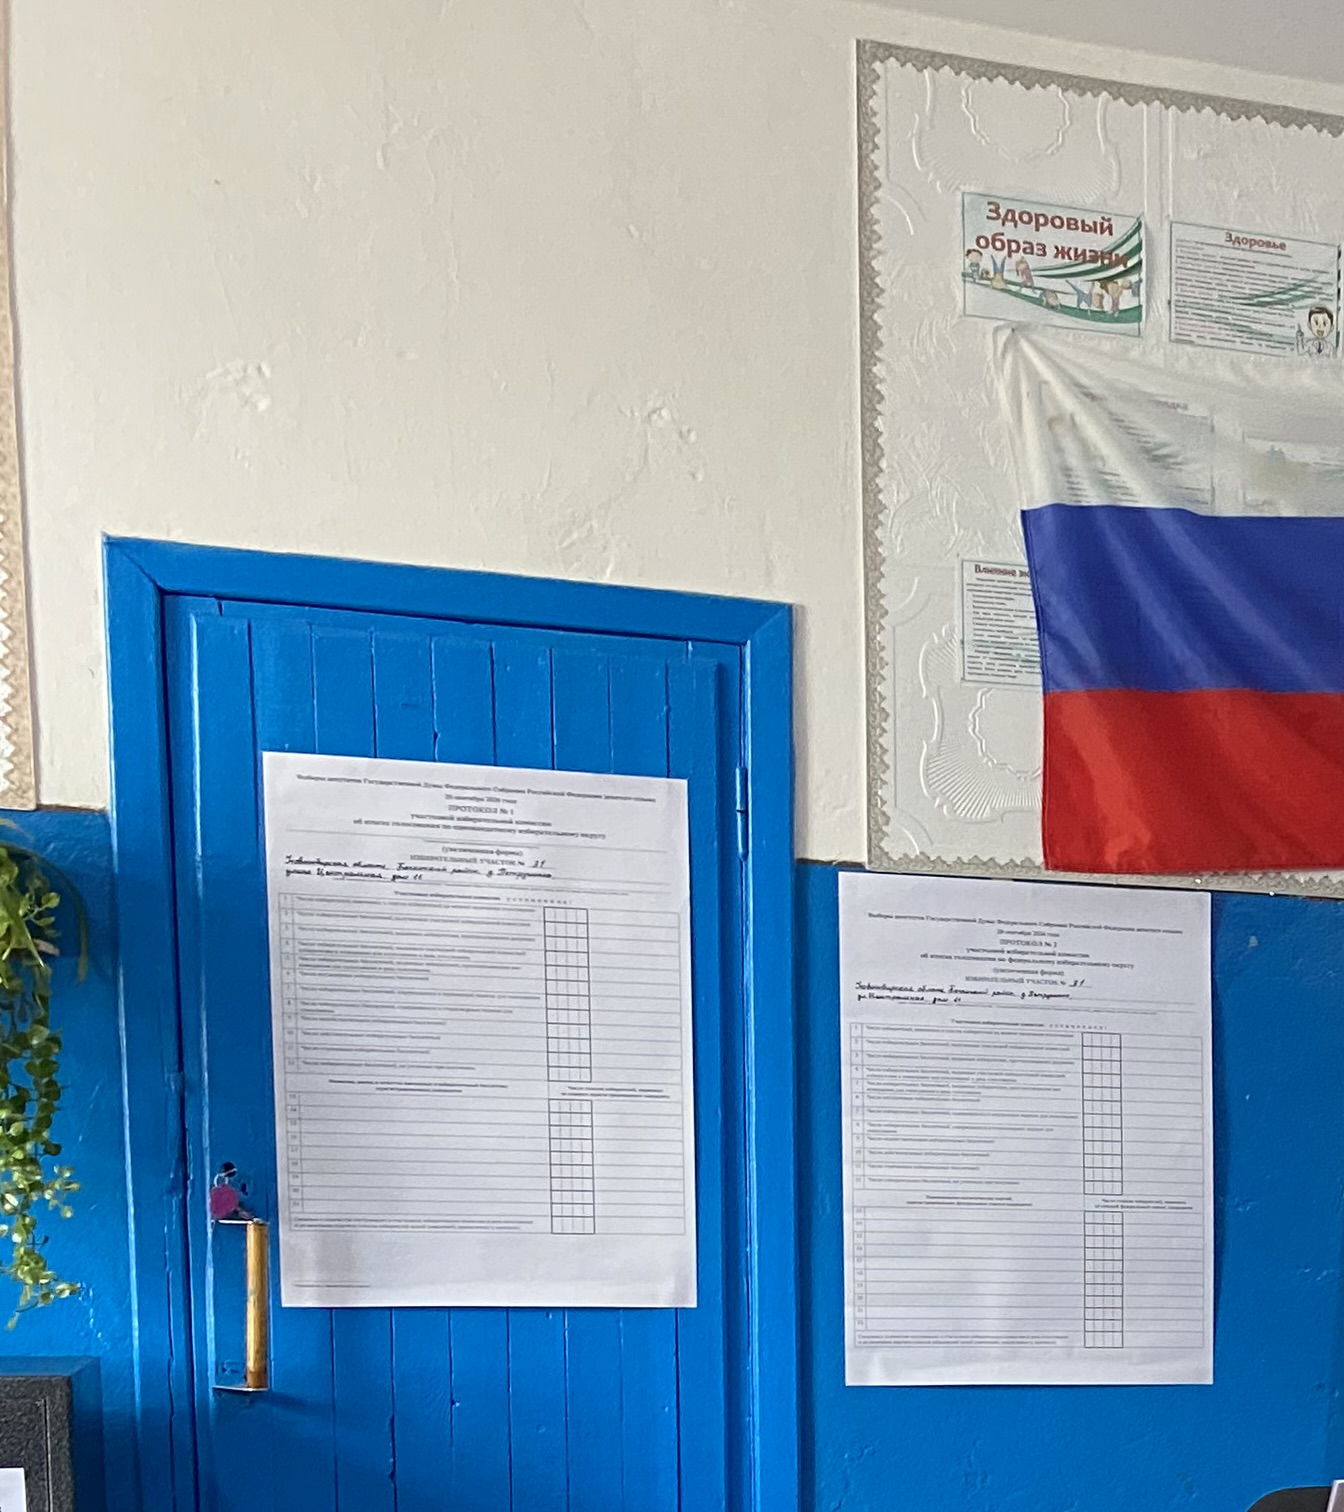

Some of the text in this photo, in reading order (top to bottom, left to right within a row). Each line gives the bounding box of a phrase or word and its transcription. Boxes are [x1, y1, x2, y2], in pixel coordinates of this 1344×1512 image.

[986, 200, 1114, 236] Здоровый
[975, 233, 1130, 268] образ жизни
[1224, 231, 1287, 252] Здоровье
